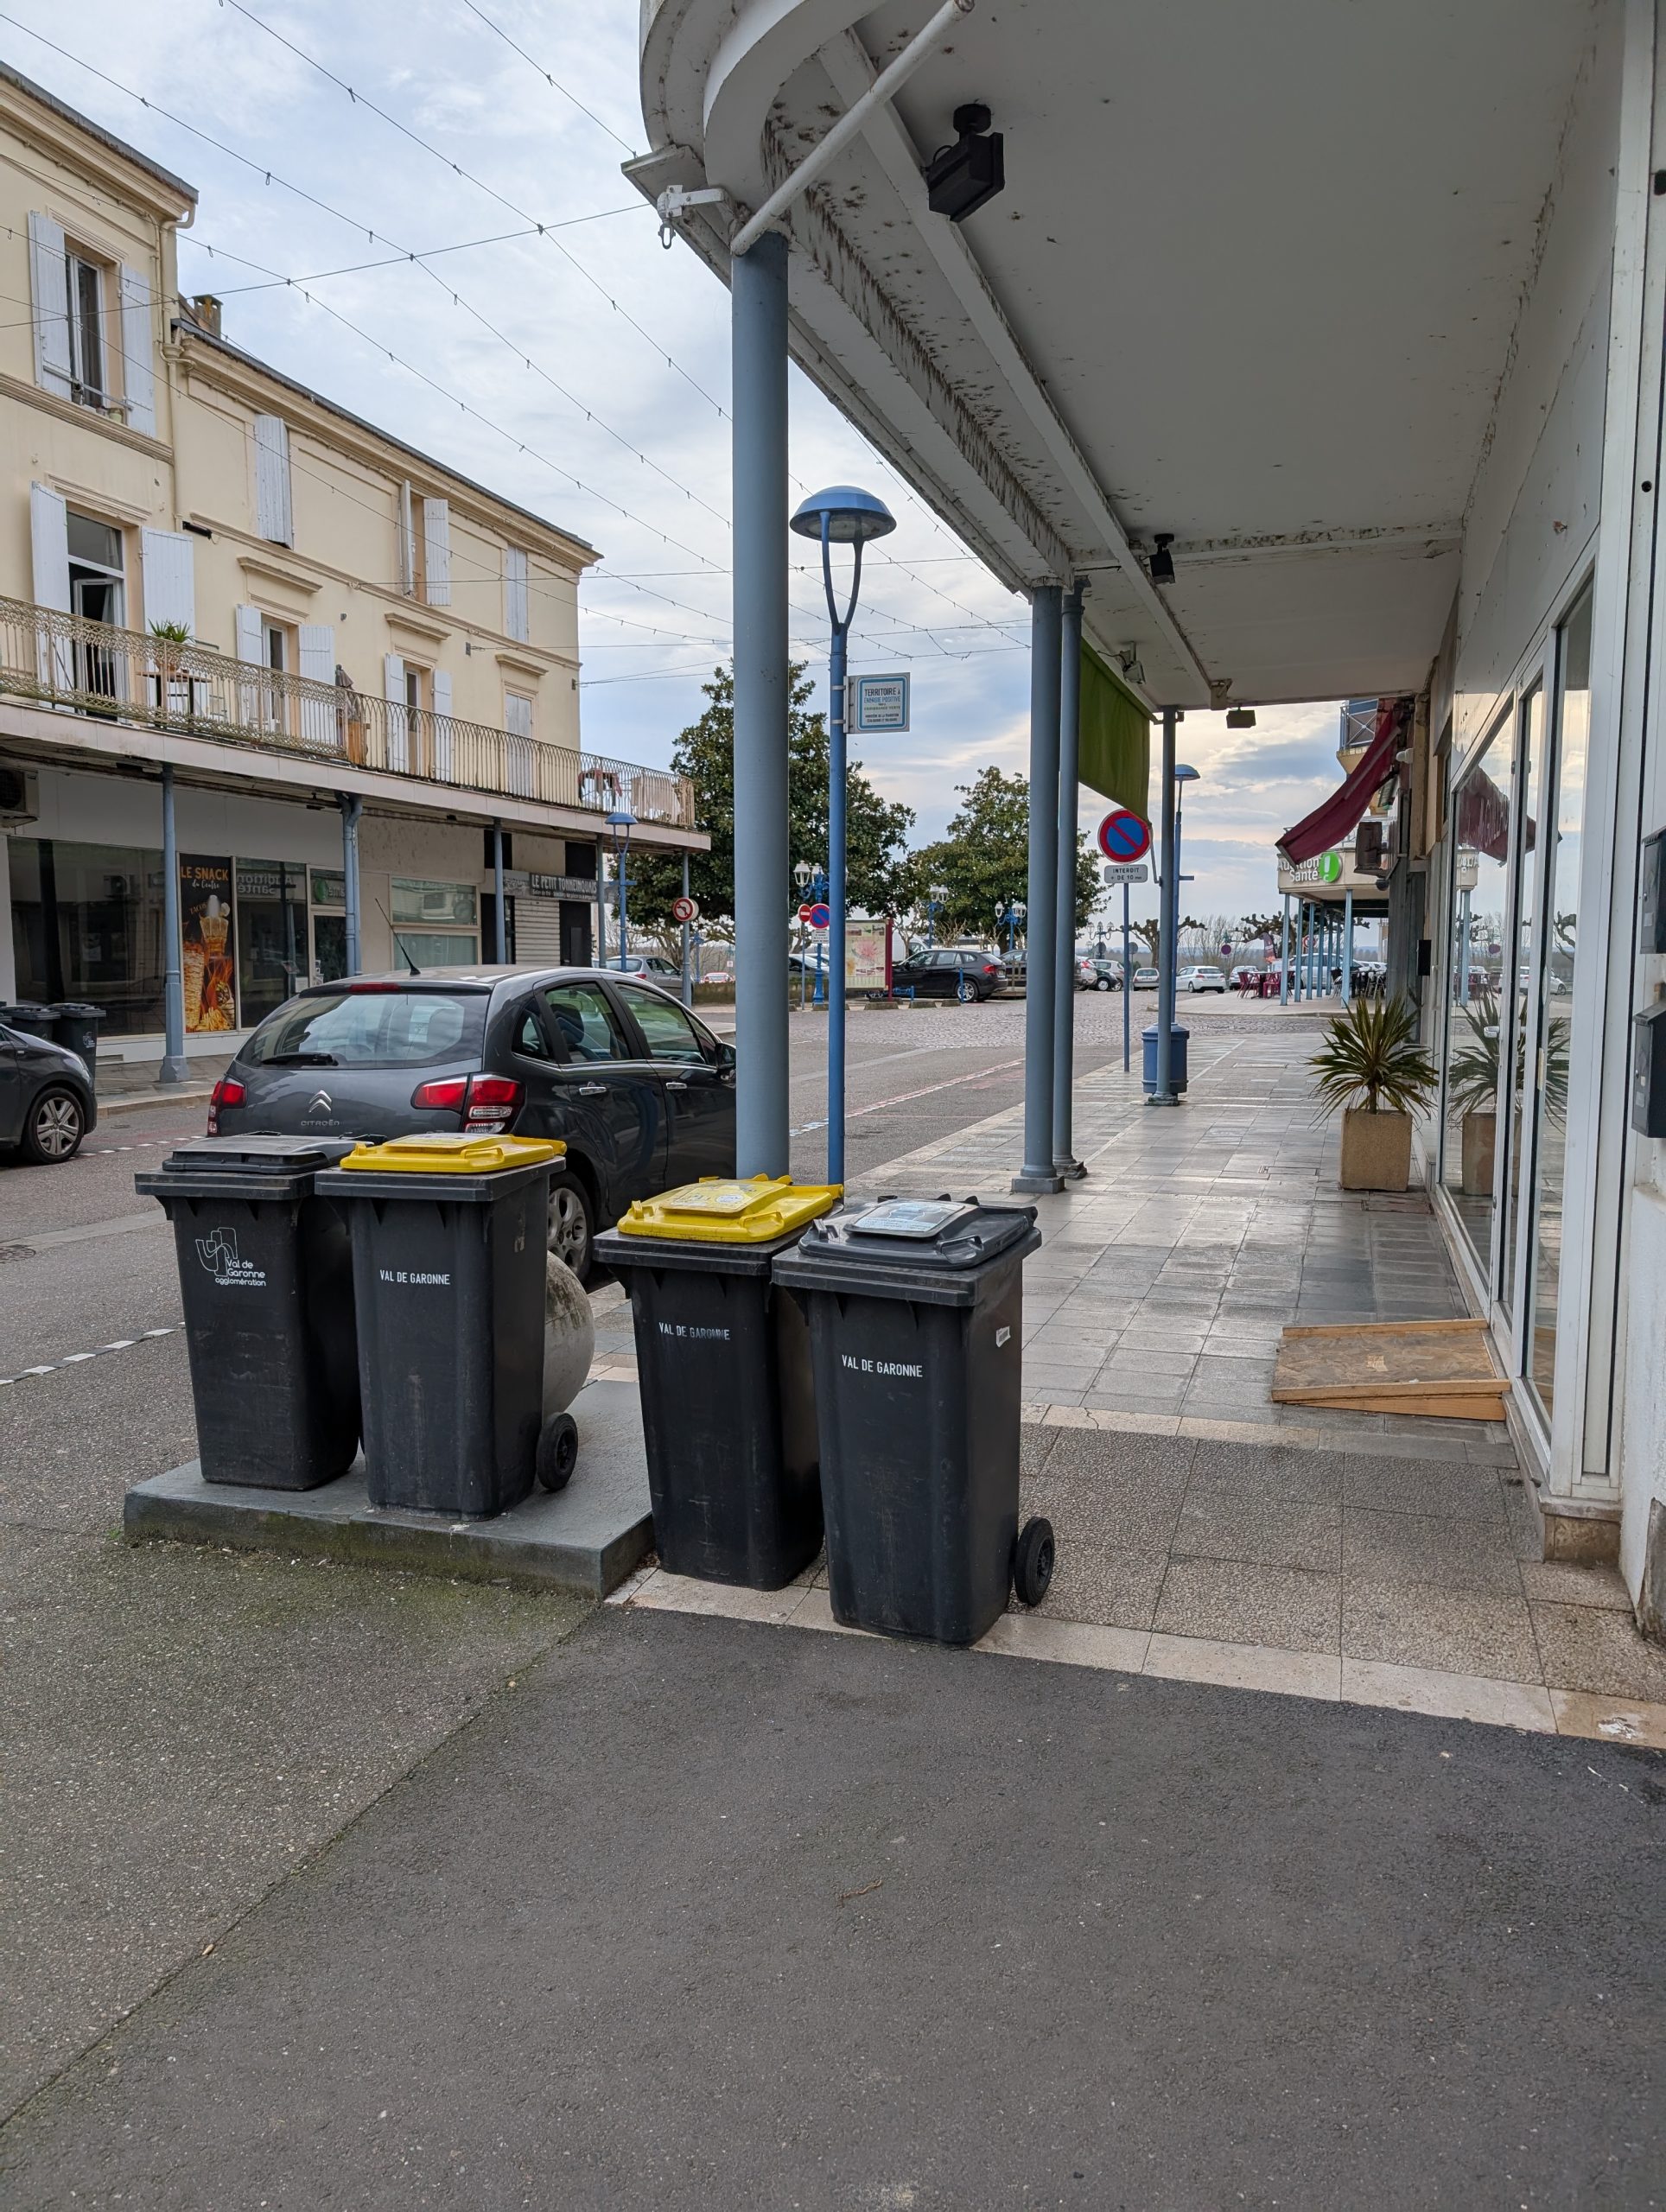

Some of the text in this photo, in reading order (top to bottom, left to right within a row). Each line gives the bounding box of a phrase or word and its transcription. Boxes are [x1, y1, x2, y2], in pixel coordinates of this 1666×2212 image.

[864, 688, 896, 696] TERRITOIRE
[181, 866, 228, 881] LE SNACK
[1289, 868, 1319, 882] Santé
[531, 874, 540, 888] LE
[540, 875, 557, 890] PETIT
[226, 1260, 253, 1269] Val de
[227, 1268, 265, 1278] Garonne
[380, 1269, 450, 1285] VAL DE GARONNE
[215, 1277, 266, 1287] agglomération
[658, 1322, 674, 1335] VAL
[677, 1325, 687, 1338] DE
[842, 1354, 923, 1377] VAL DE GARONNE
